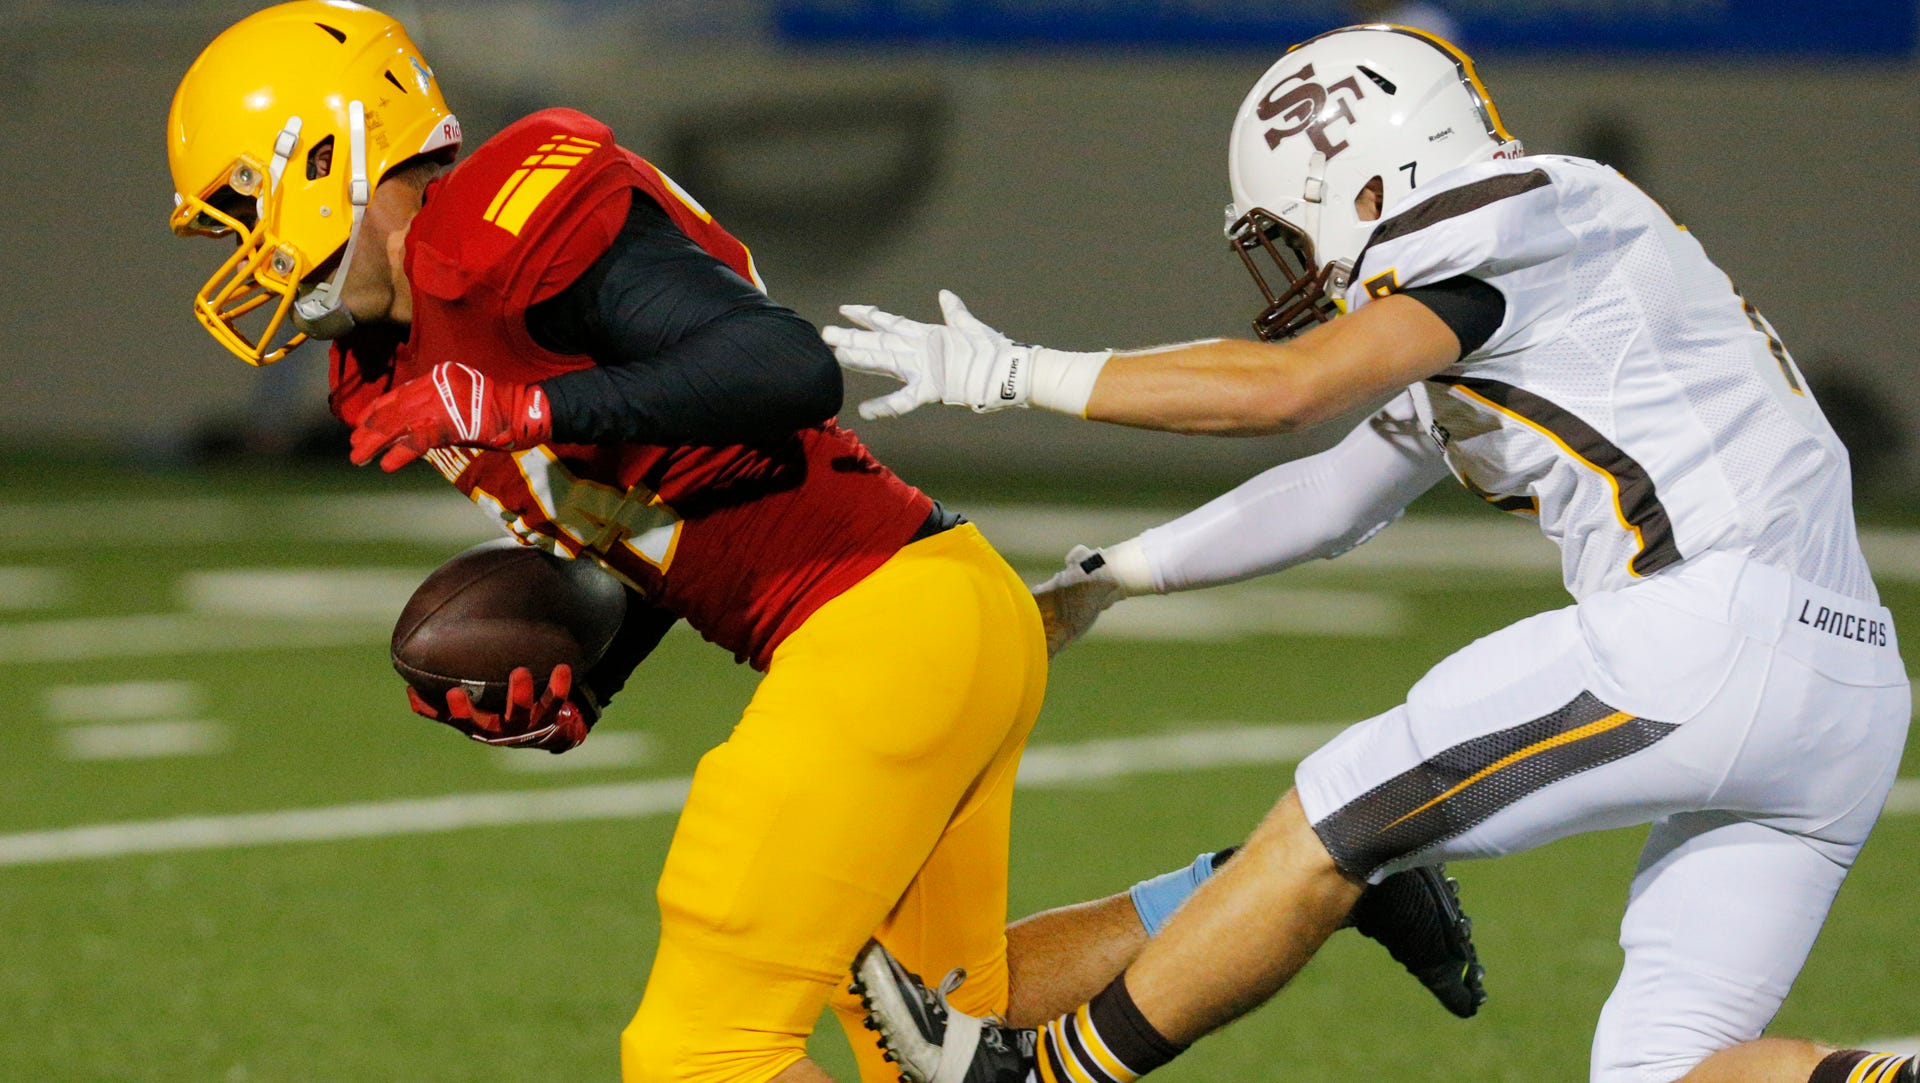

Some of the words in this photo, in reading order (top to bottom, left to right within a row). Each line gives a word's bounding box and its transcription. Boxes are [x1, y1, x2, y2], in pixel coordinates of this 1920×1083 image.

[1256, 63, 1364, 161] SF
[1399, 161, 1417, 189] 7
[1798, 599, 1886, 647] LANCERS
